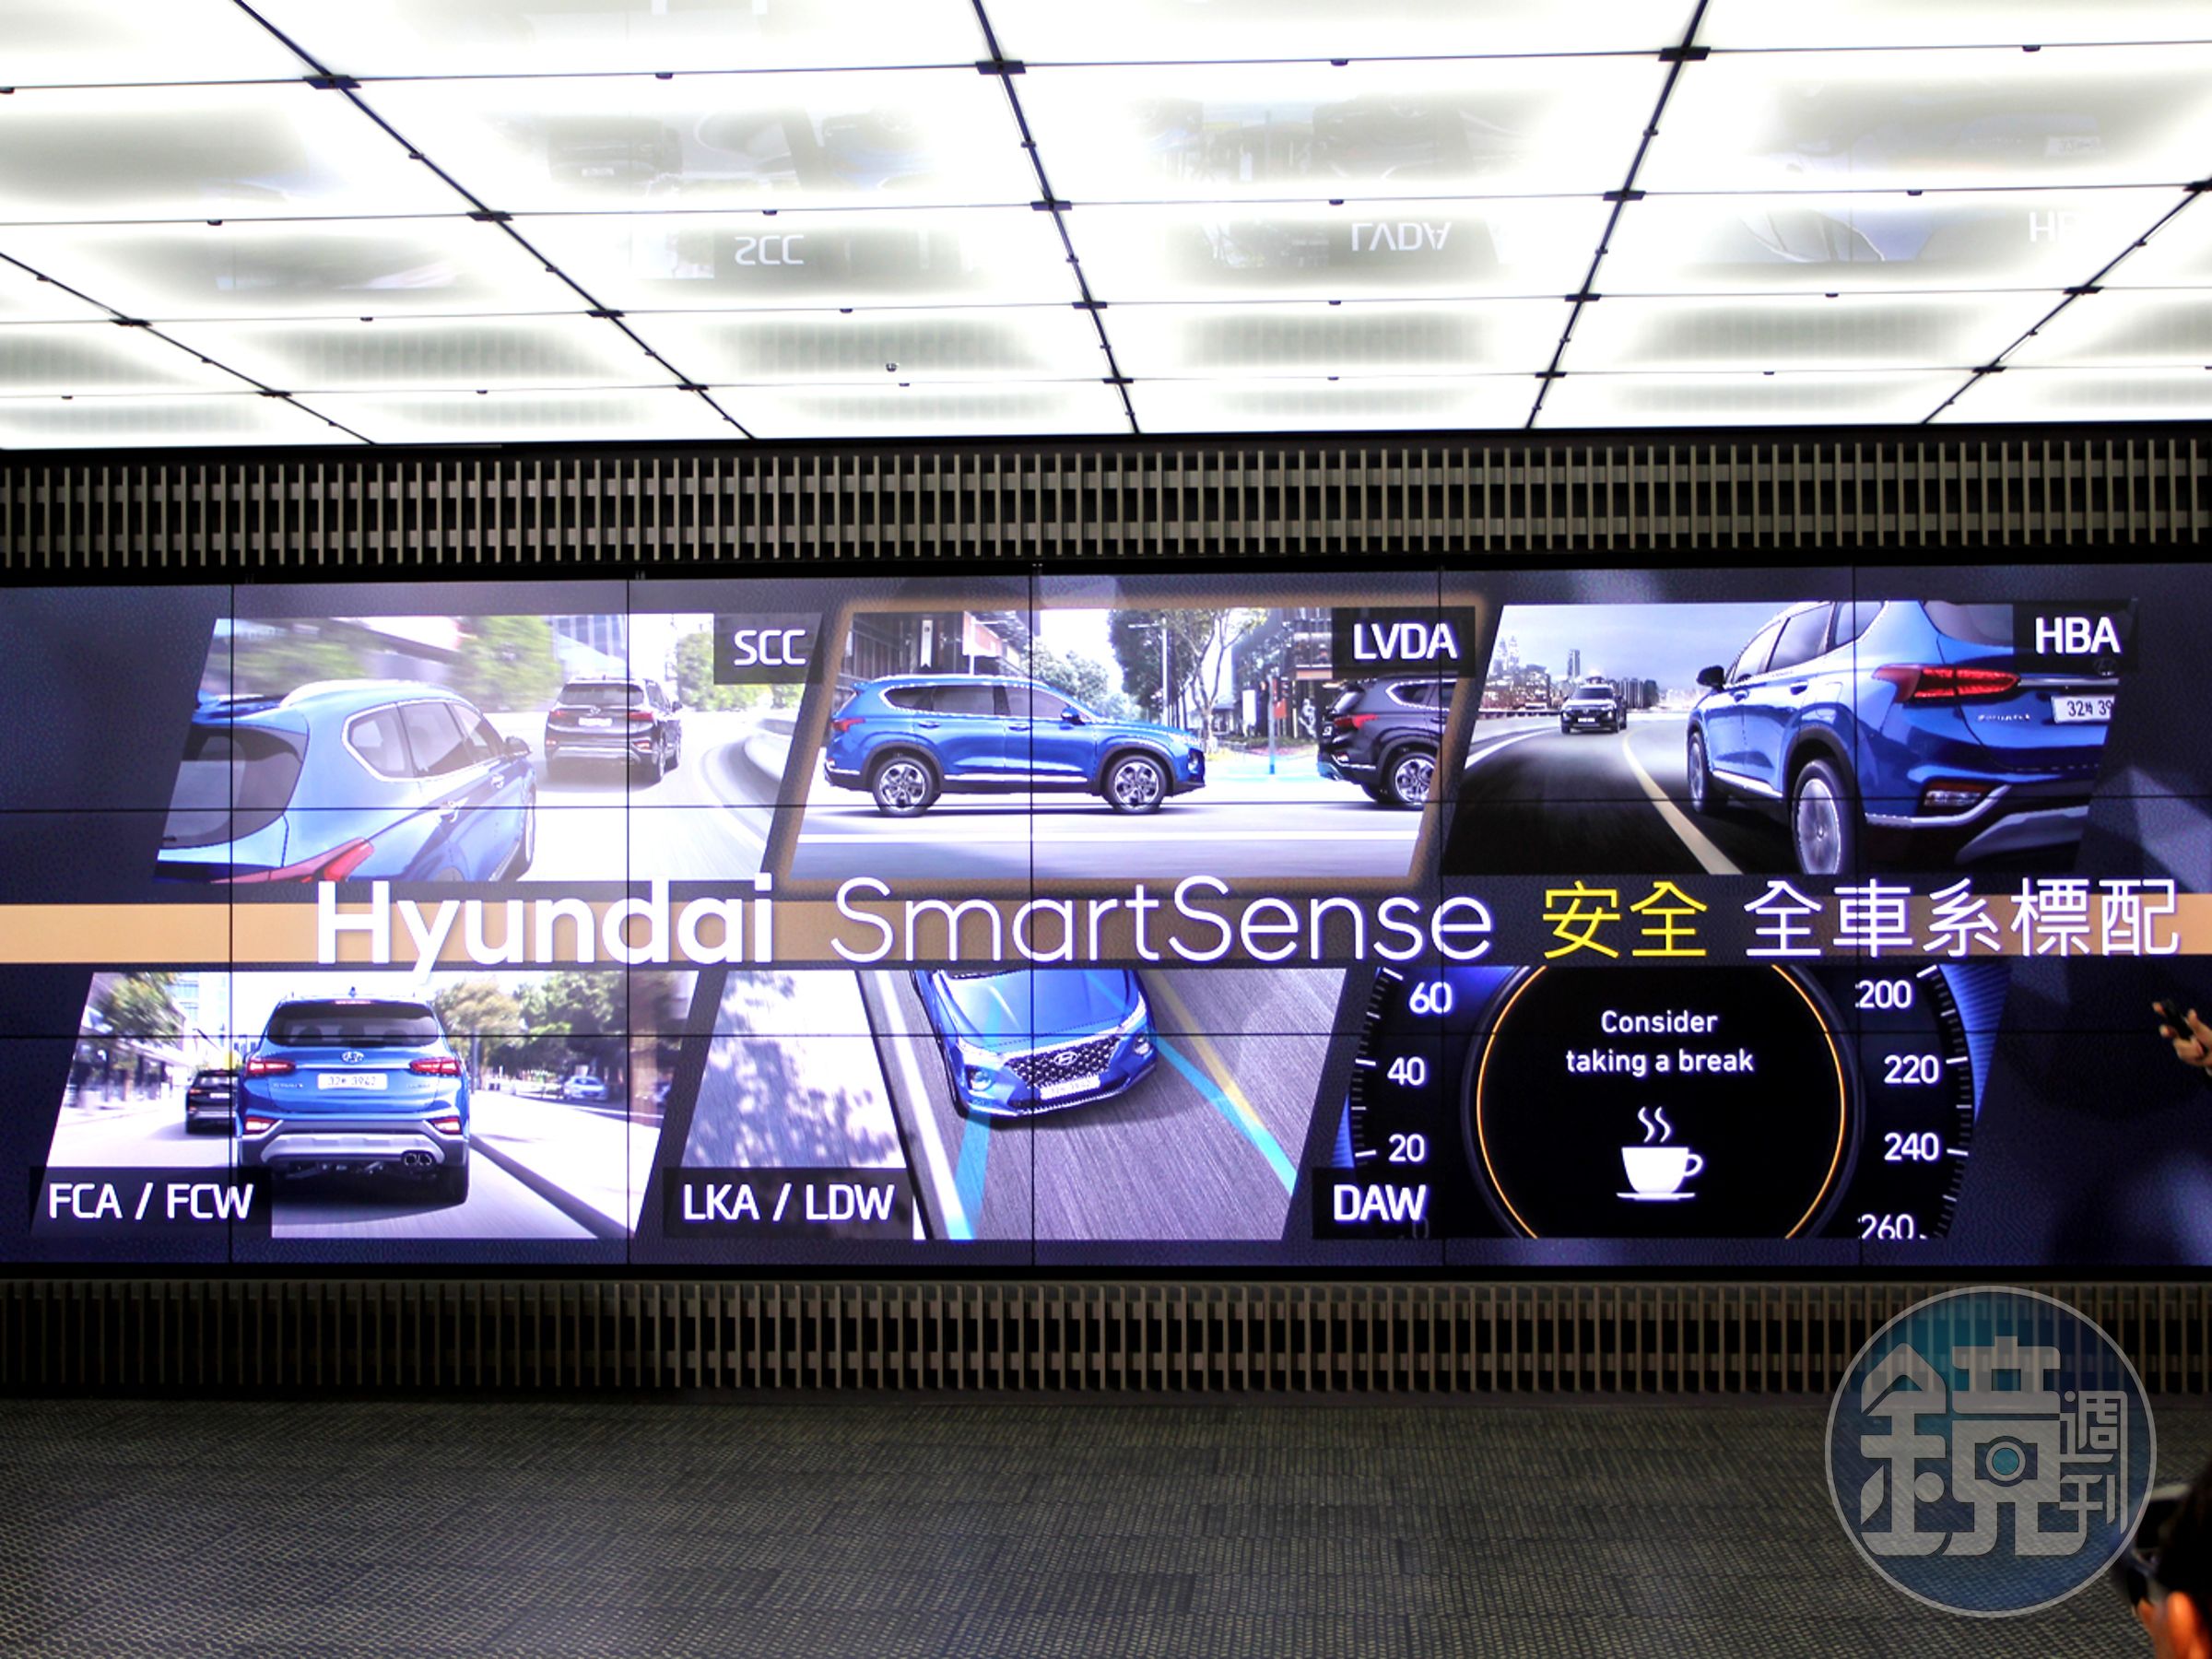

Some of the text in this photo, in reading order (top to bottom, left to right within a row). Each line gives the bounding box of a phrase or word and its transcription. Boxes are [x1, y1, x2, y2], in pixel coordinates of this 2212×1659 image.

[734, 629, 806, 665] SCC
[1353, 623, 1458, 660] LVDA
[2035, 616, 2122, 654] HBA
[317, 871, 2181, 984] Hyundai SmartSense 安全 全車系標配
[1408, 982, 1453, 1014] 60
[1856, 980, 1912, 1009] 200
[1600, 1009, 1719, 1033] Consider
[1387, 1056, 1426, 1087] 40
[1565, 1048, 1754, 1078] taking a break
[1883, 1054, 1940, 1084] 220
[1388, 1133, 1426, 1163] 20
[1883, 1133, 1940, 1161] 240
[49, 1182, 254, 1220] FCA / FCW
[684, 1182, 896, 1221] LKA / LDW
[1333, 1182, 1428, 1222] DAW
[1860, 1213, 1915, 1240] 260
